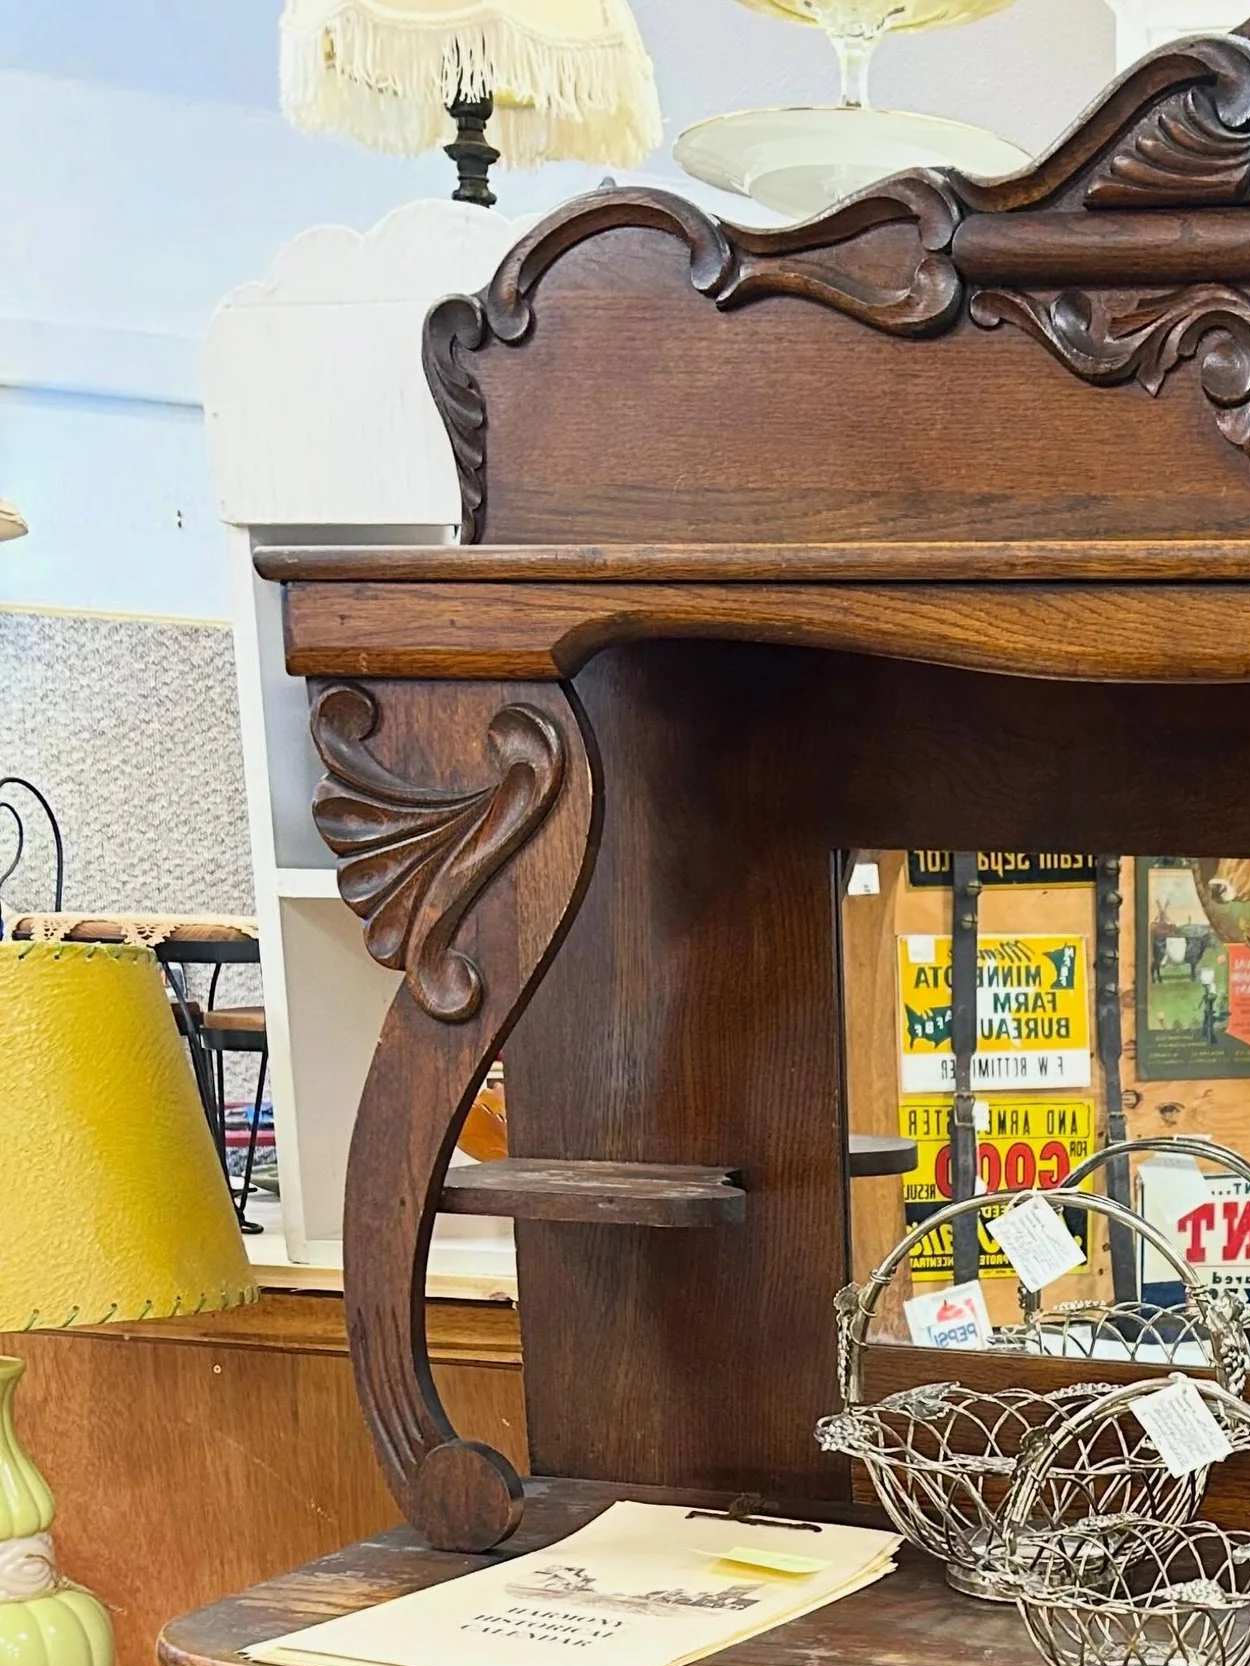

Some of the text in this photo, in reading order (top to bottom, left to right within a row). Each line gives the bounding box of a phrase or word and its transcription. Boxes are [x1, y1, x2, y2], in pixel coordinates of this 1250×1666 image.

[474, 1614, 619, 1640] HISTORICAL
[507, 1606, 626, 1629] HARMONY
[460, 1623, 593, 1648] CALENDAR
